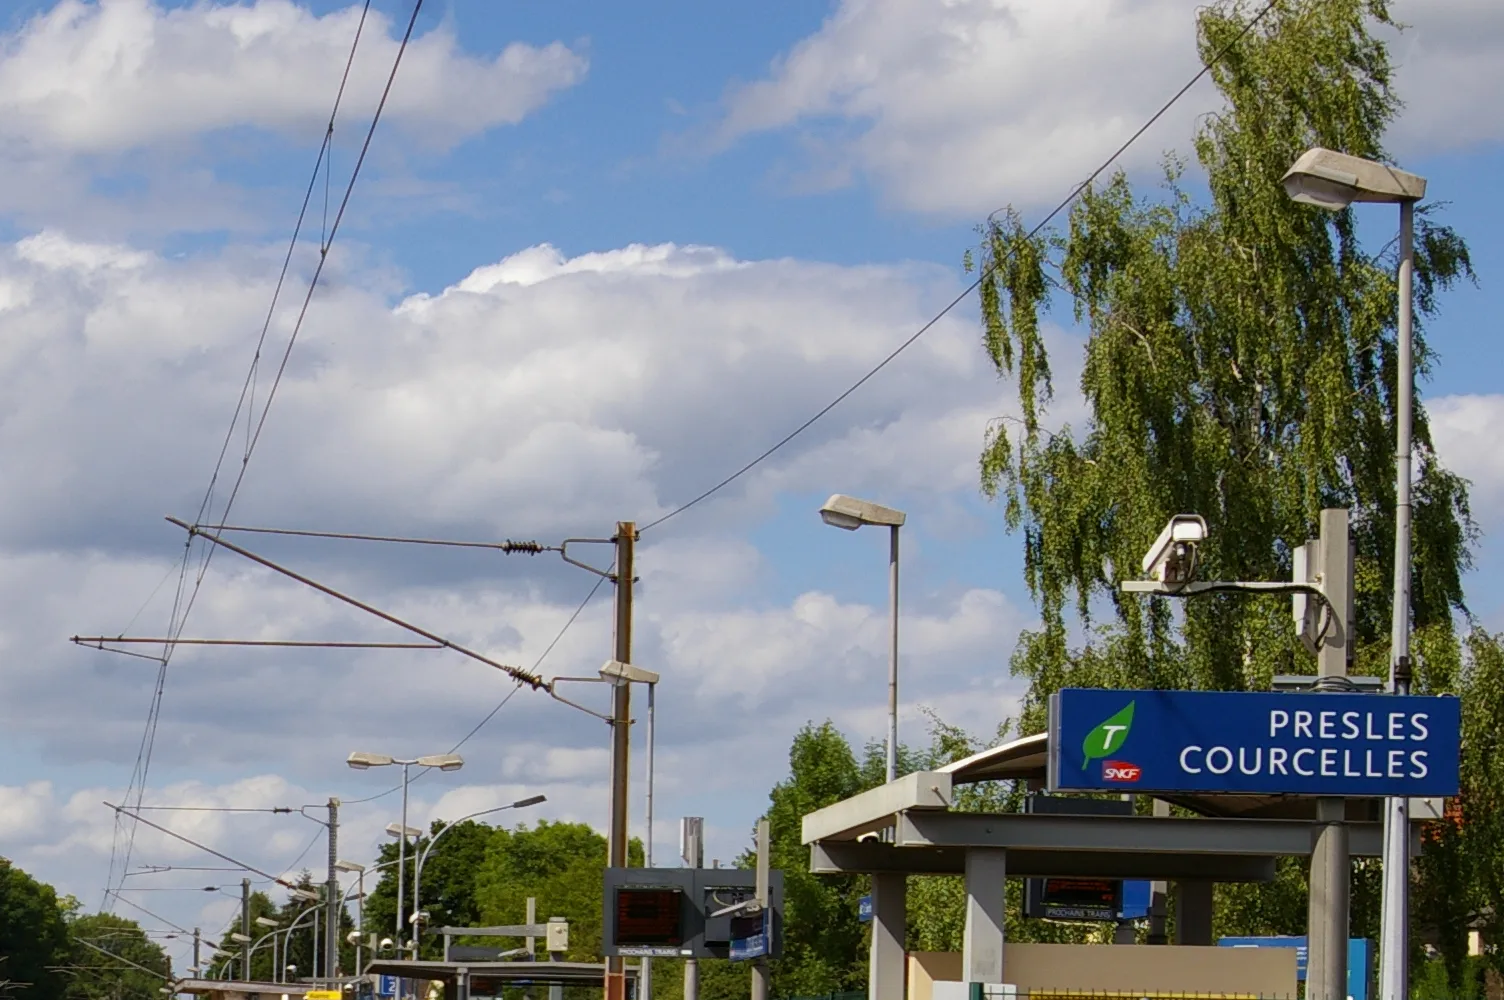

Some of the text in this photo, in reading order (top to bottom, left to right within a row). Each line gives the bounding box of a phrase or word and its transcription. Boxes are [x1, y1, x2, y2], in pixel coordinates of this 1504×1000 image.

[1102, 725, 1127, 750] T
[1269, 710, 1429, 741] PRESLES
[1103, 768, 1141, 779] SNCF
[1179, 745, 1429, 779] COURCELLES
